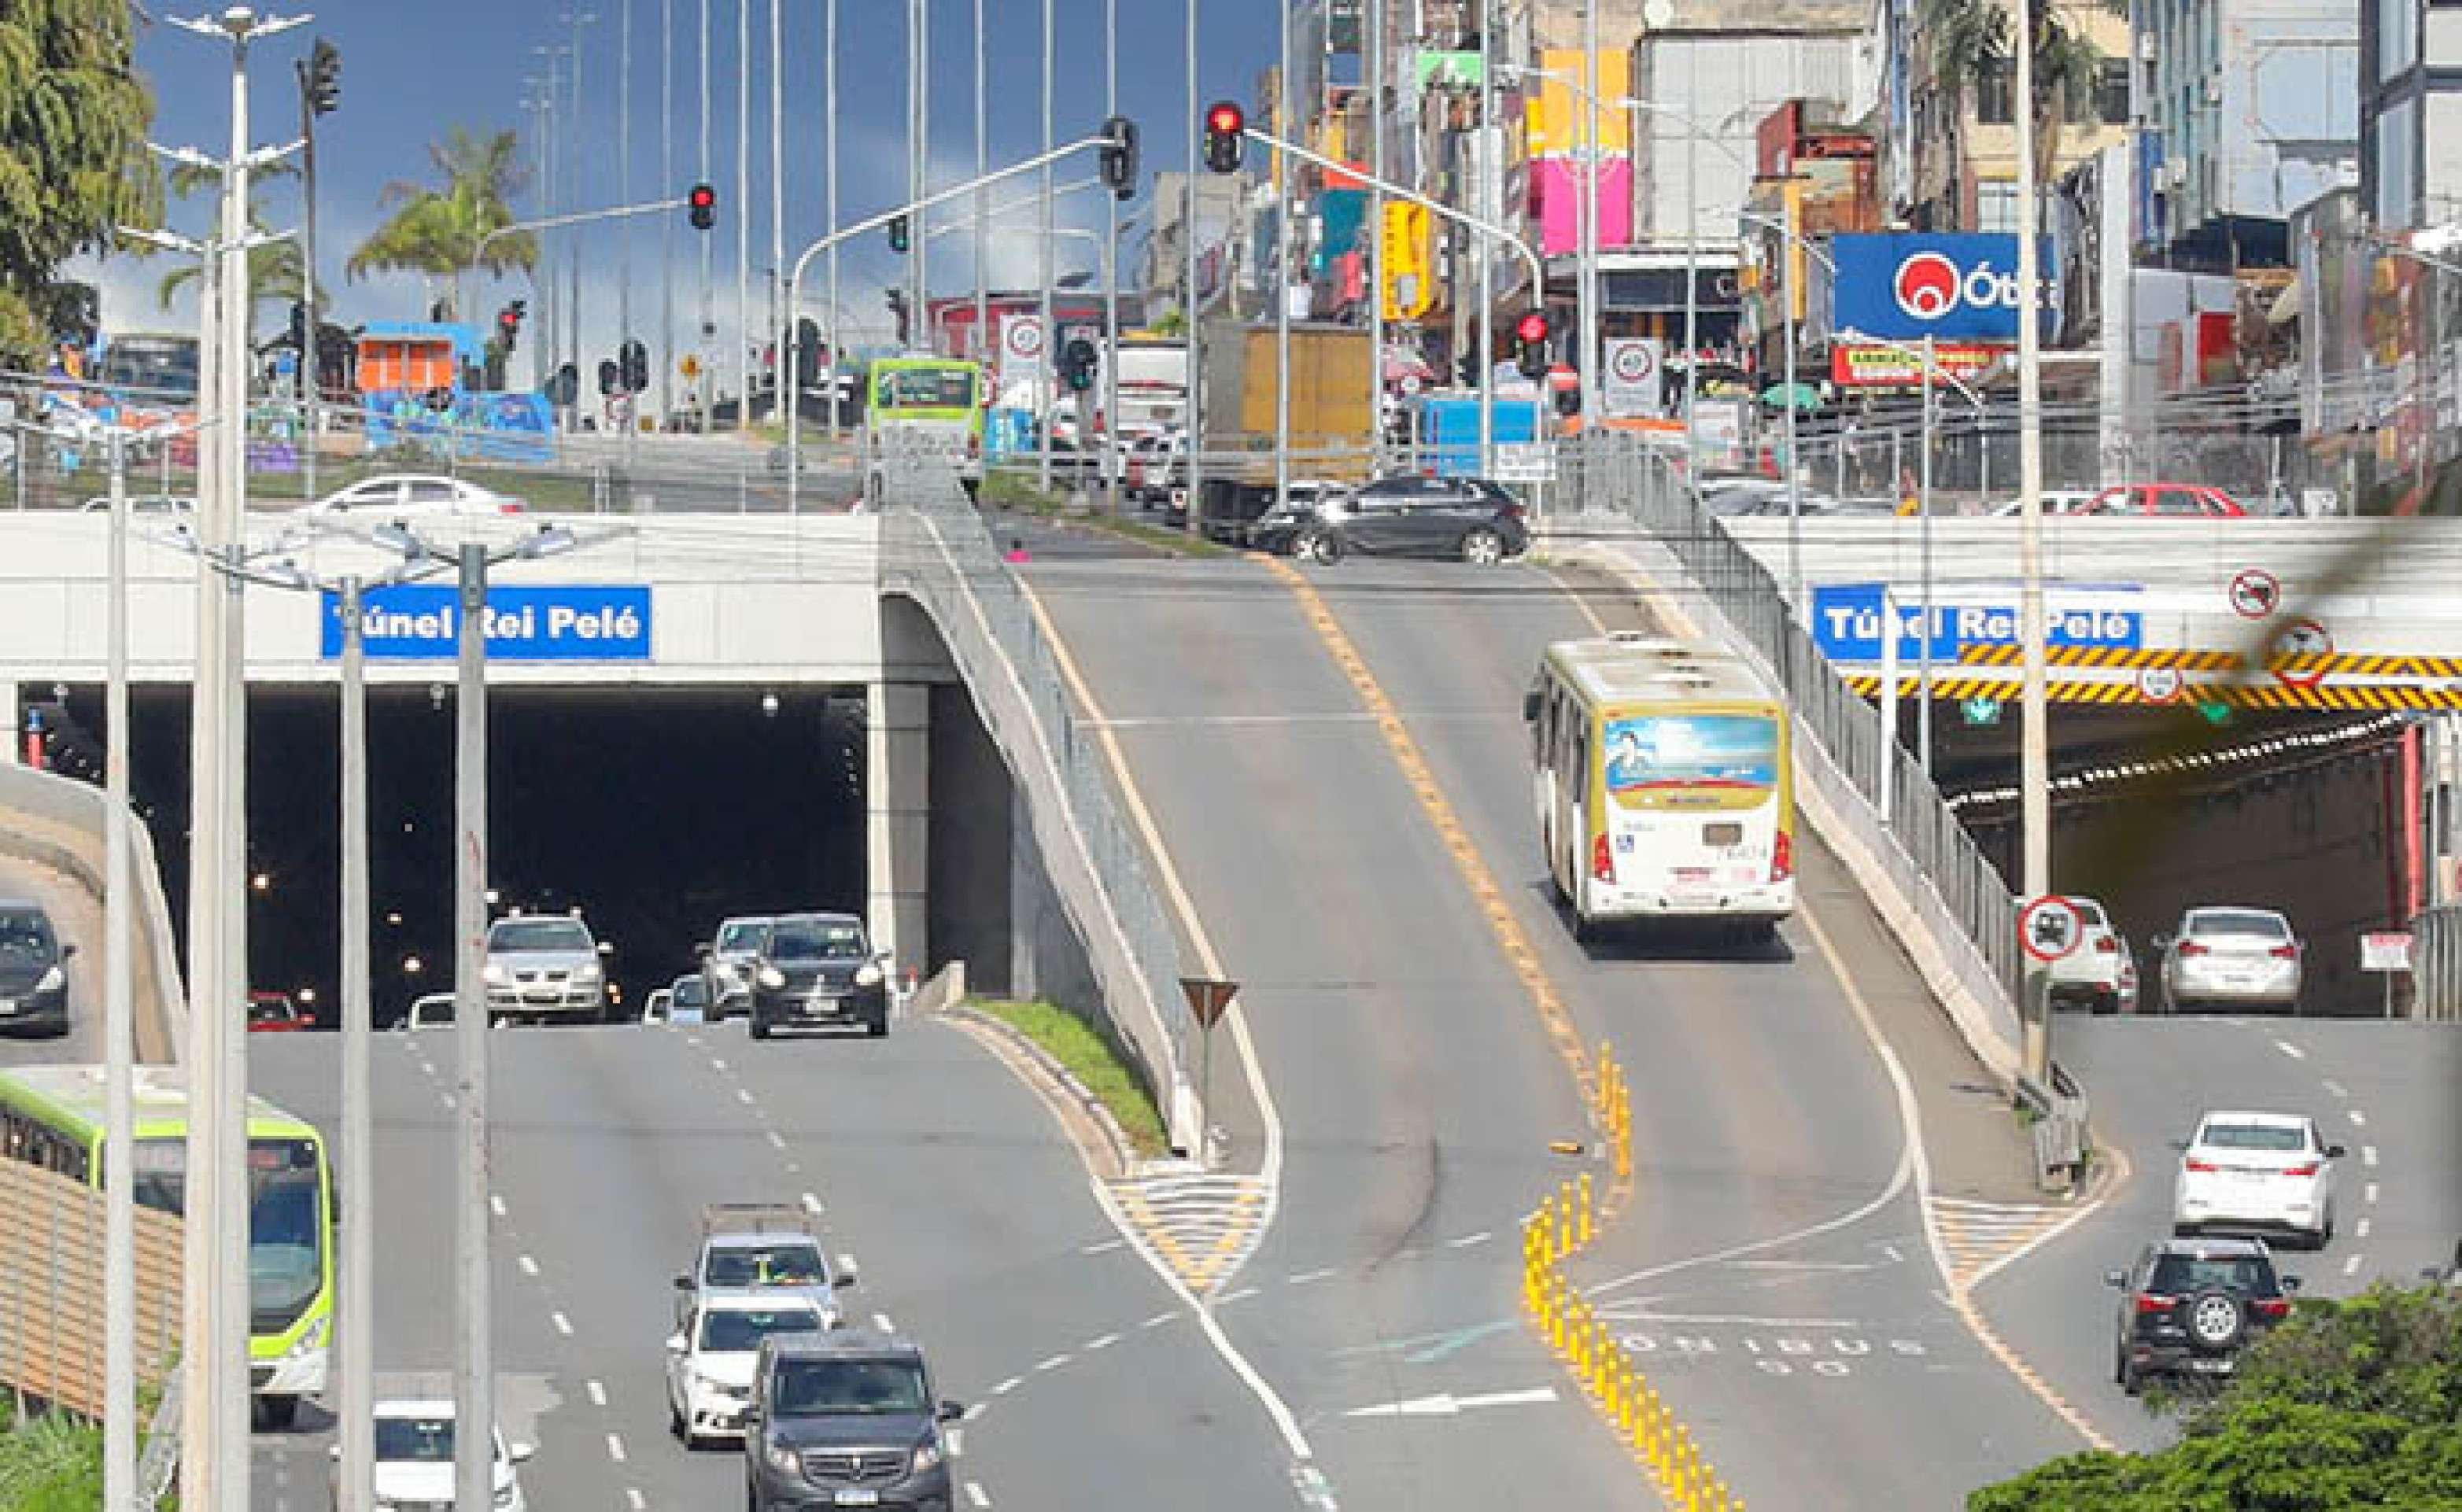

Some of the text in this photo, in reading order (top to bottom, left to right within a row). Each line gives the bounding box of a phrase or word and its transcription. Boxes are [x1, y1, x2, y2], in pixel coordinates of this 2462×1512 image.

[334, 604, 453, 639] únel
[548, 604, 641, 639] Pelé
[1824, 607, 1944, 639] Túel
